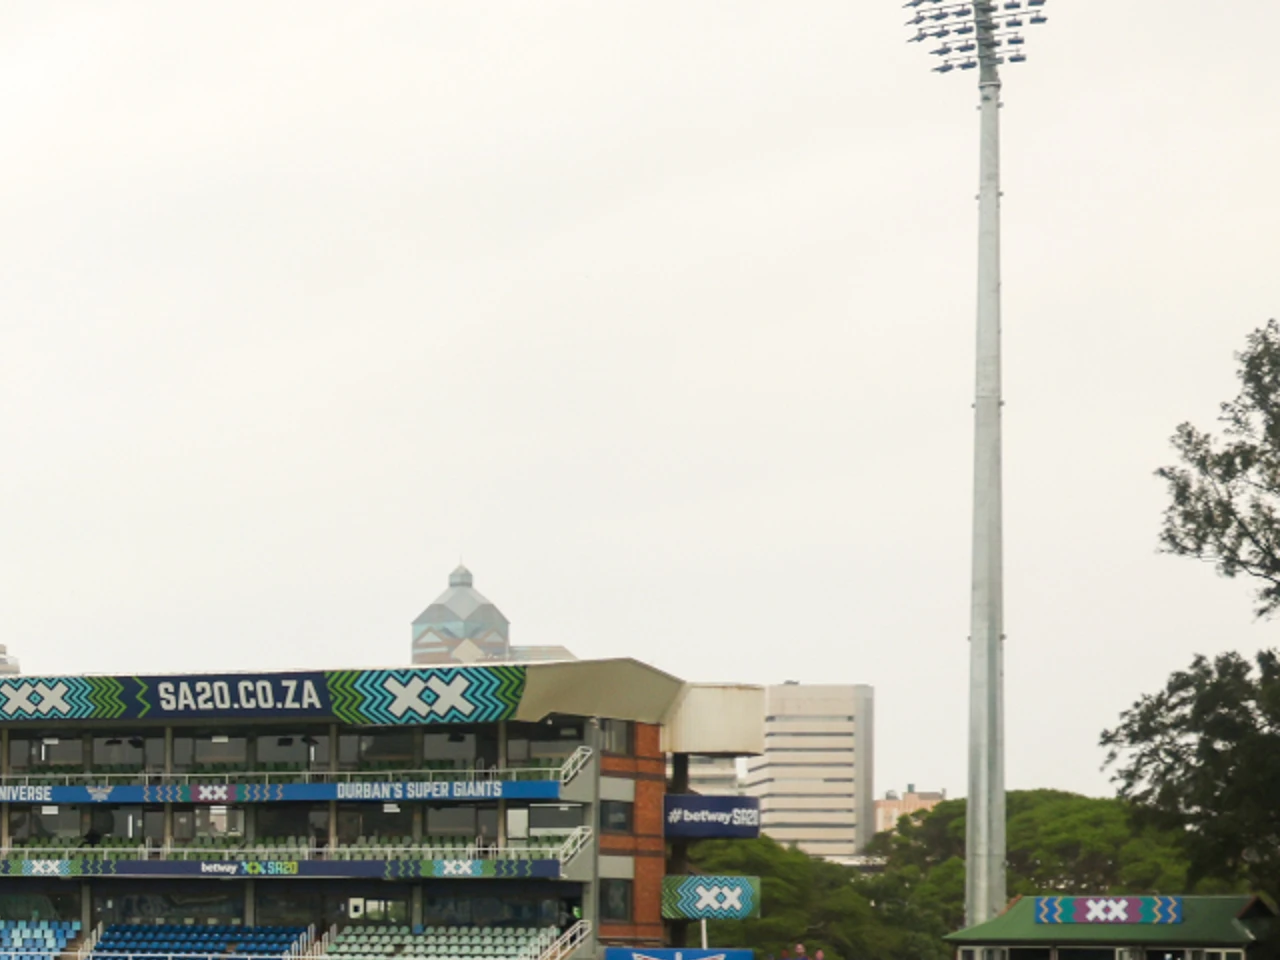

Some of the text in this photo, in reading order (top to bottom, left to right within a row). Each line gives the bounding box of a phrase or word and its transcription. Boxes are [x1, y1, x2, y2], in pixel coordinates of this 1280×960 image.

[159, 679, 322, 711] SA20.CO.ZA
[336, 780, 502, 800] DURBAN'S SUPER GIANTS
[201, 862, 237, 875] betway
